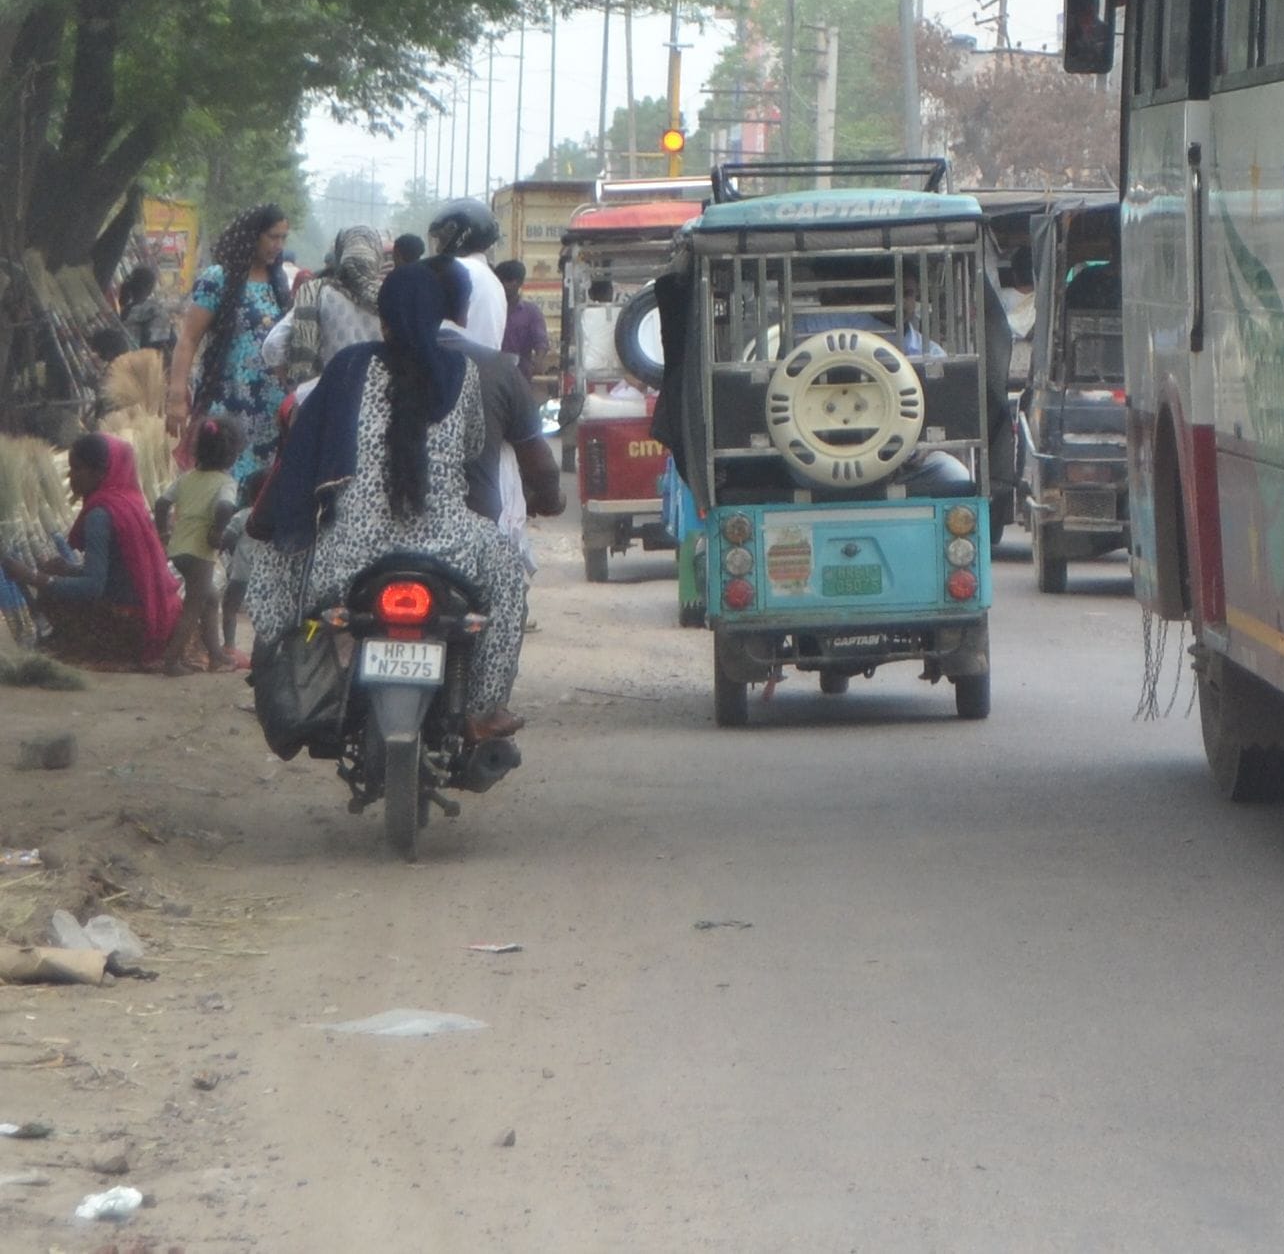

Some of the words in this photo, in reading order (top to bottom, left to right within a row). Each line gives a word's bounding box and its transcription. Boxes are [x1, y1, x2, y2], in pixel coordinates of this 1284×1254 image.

[775, 199, 902, 220] CAPTAIN
[628, 440, 663, 458] CITY
[378, 659, 432, 677] N7575
